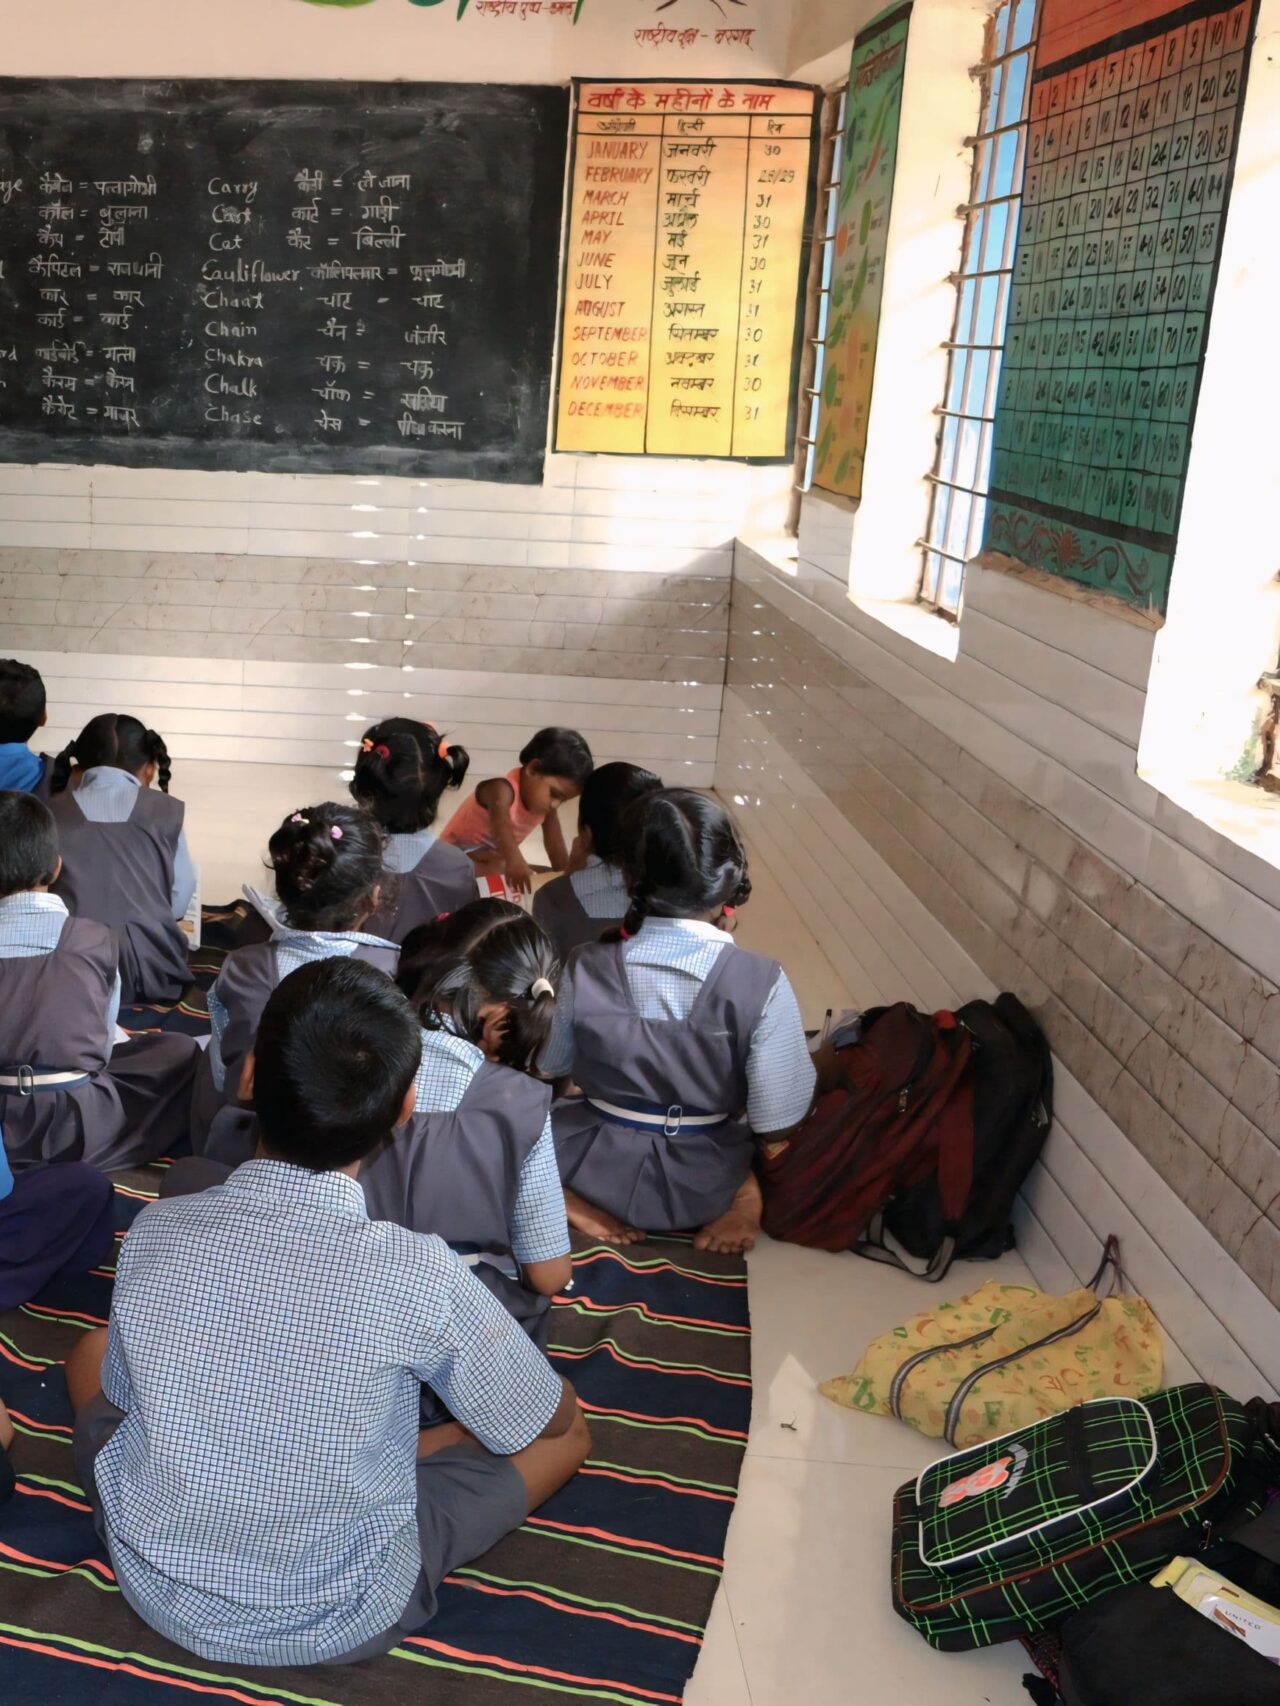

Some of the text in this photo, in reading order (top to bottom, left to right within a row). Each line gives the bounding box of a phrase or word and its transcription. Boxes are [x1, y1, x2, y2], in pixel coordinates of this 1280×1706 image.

[626, 87, 646, 110] के
[654, 87, 714, 112] महीनों
[718, 87, 735, 109] के
[742, 93, 775, 111] नाम
[586, 140, 648, 160] JANUARY
[764, 144, 781, 156] 30
[585, 166, 653, 184] FEBRUARY
[207, 177, 258, 203] Carry
[582, 189, 629, 206] MARCH
[756, 194, 771, 208] 31
[581, 210, 624, 226] APRIL
[753, 215, 771, 229] 30
[209, 232, 243, 251] Cat
[352, 225, 406, 250] बिल्ली
[581, 229, 612, 245] MAY
[752, 234, 769, 249] 31
[577, 252, 616, 268] JUNE
[749, 256, 766, 271] 30
[201, 257, 300, 283] Cauliflower
[575, 273, 613, 290] JULY
[205, 321, 257, 337] Chain
[572, 325, 647, 342] SEPTEMBER
[205, 348, 263, 368] Chakra
[571, 351, 638, 366] OCTOBER
[205, 373, 257, 398] Chalk
[571, 375, 645, 391] NOVEMBER
[205, 403, 262, 425] Chase
[567, 400, 644, 418] DECEMBER
